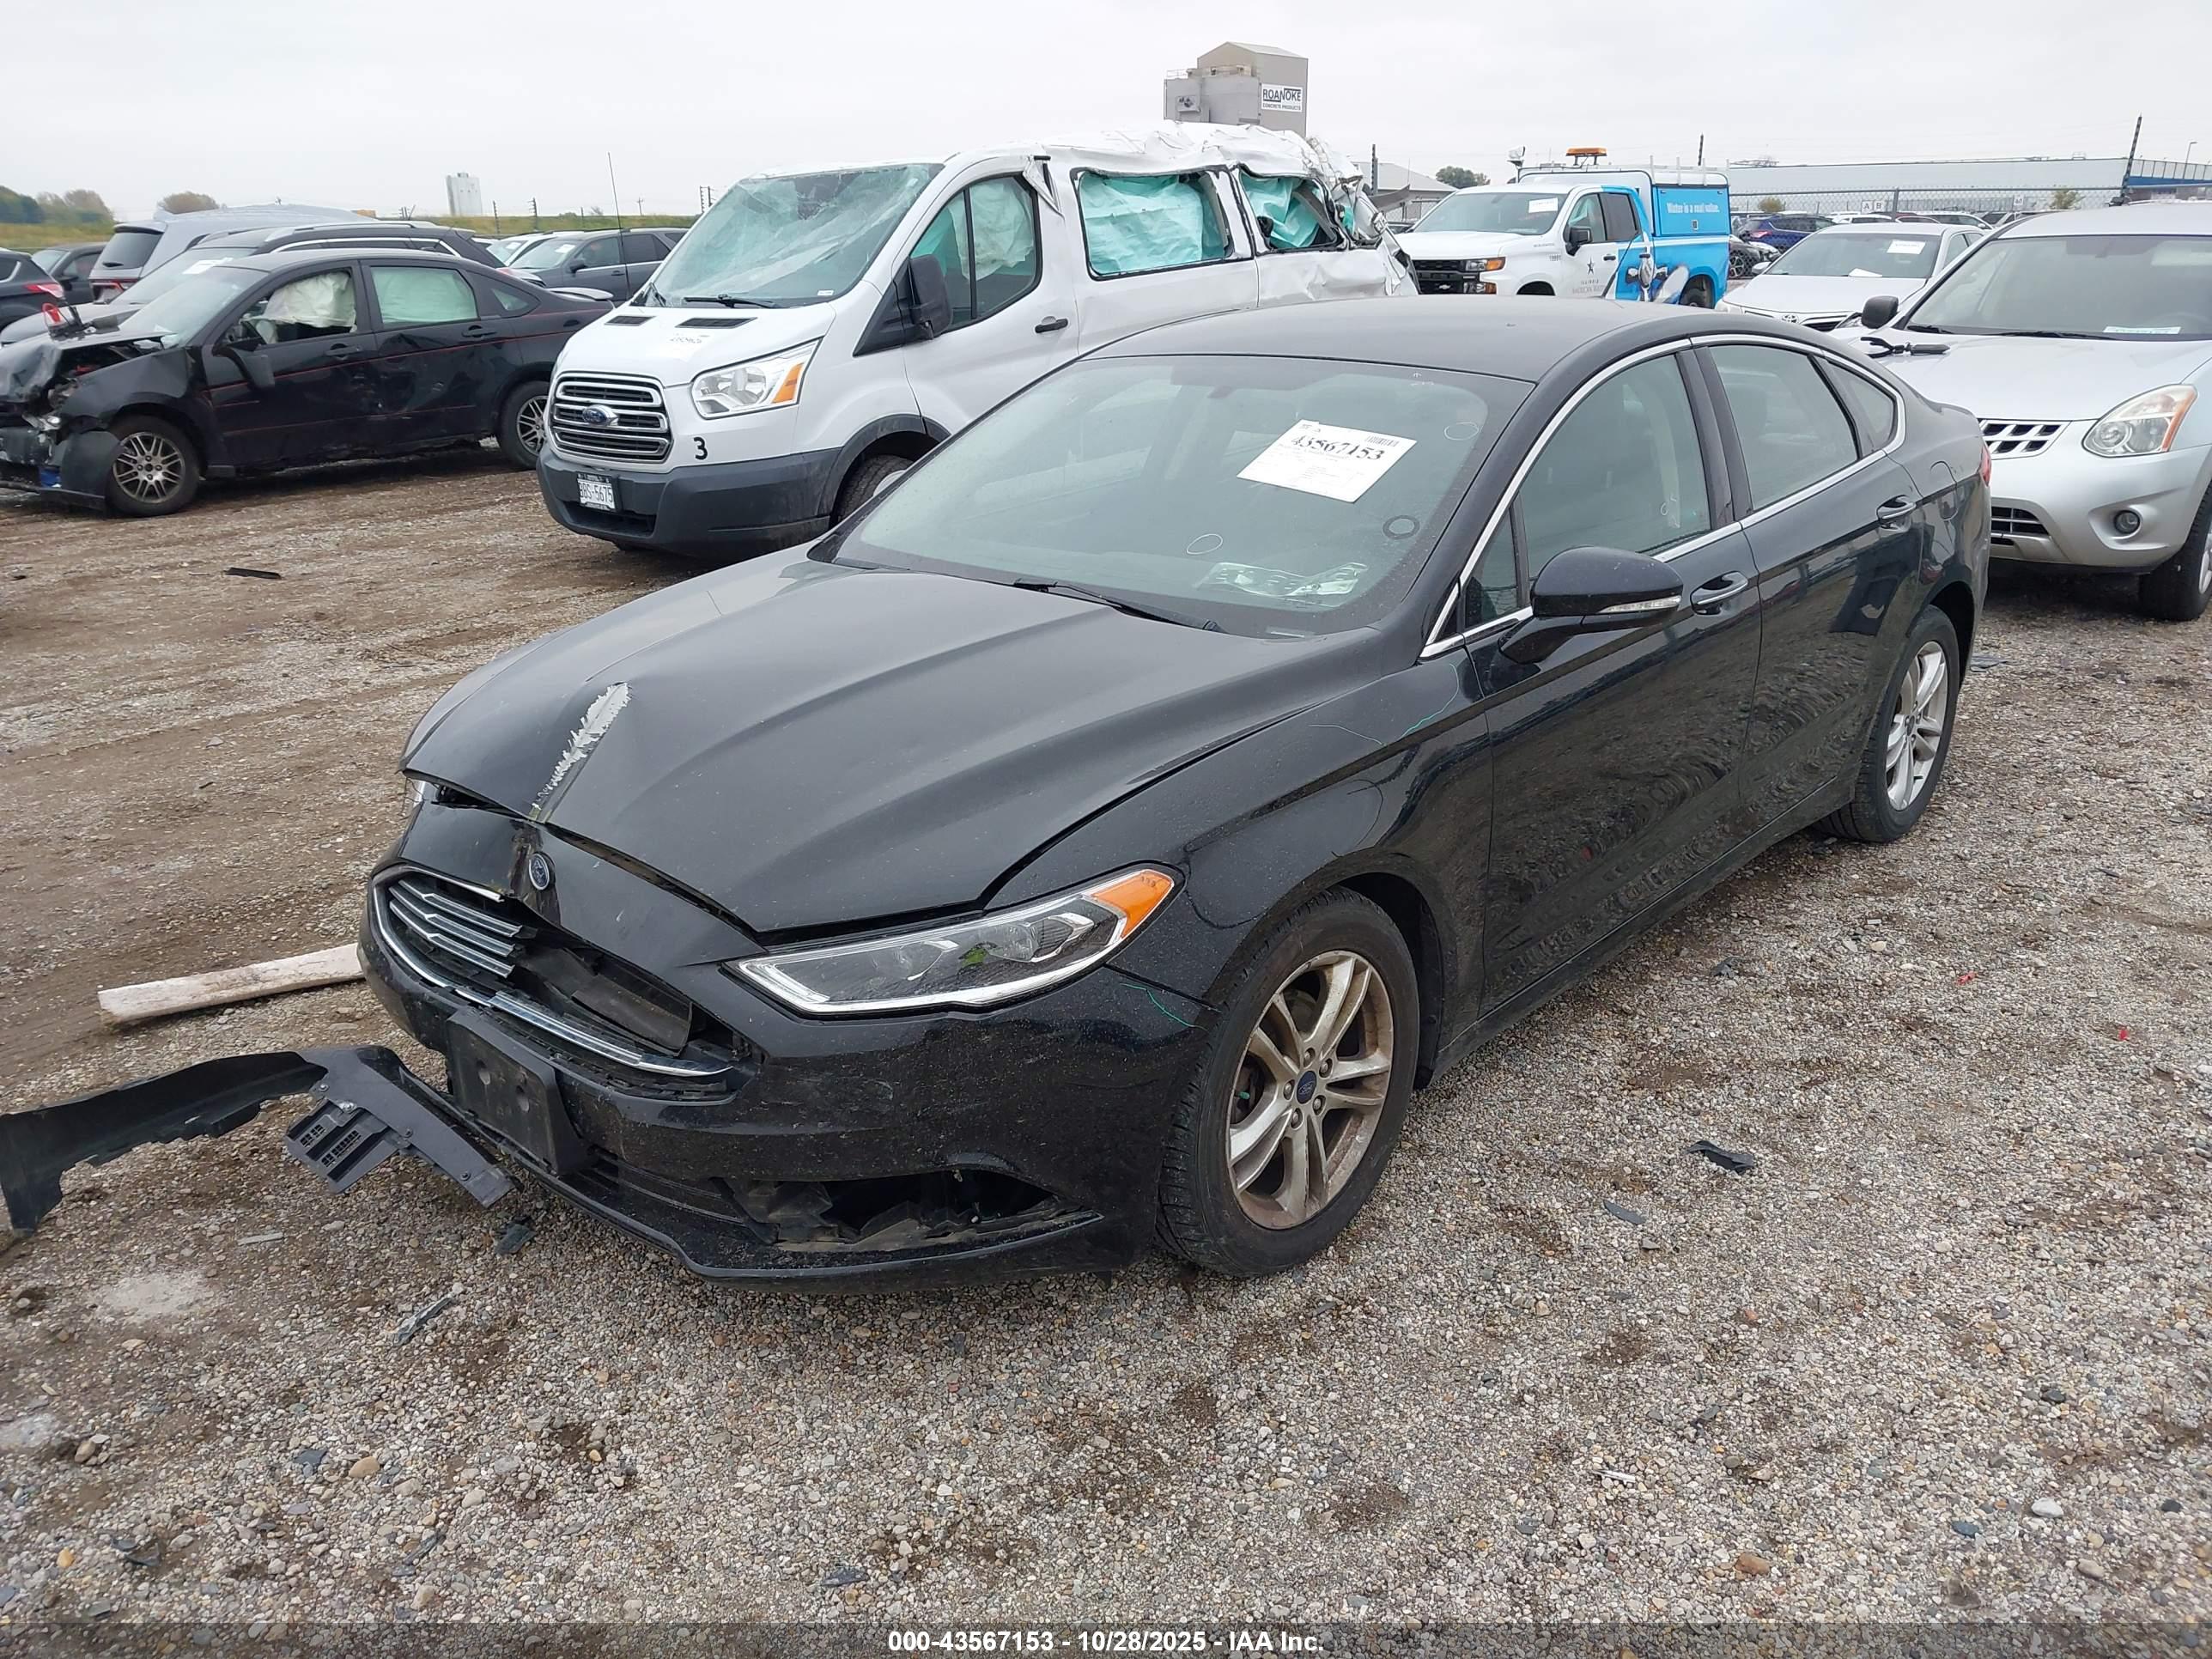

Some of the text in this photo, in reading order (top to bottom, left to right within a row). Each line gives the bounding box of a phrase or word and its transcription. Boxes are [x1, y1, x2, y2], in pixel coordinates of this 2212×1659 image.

[1263, 88, 1301, 101] ROANOKE
[694, 436, 708, 459] 3
[1291, 435, 1384, 459] 43567153
